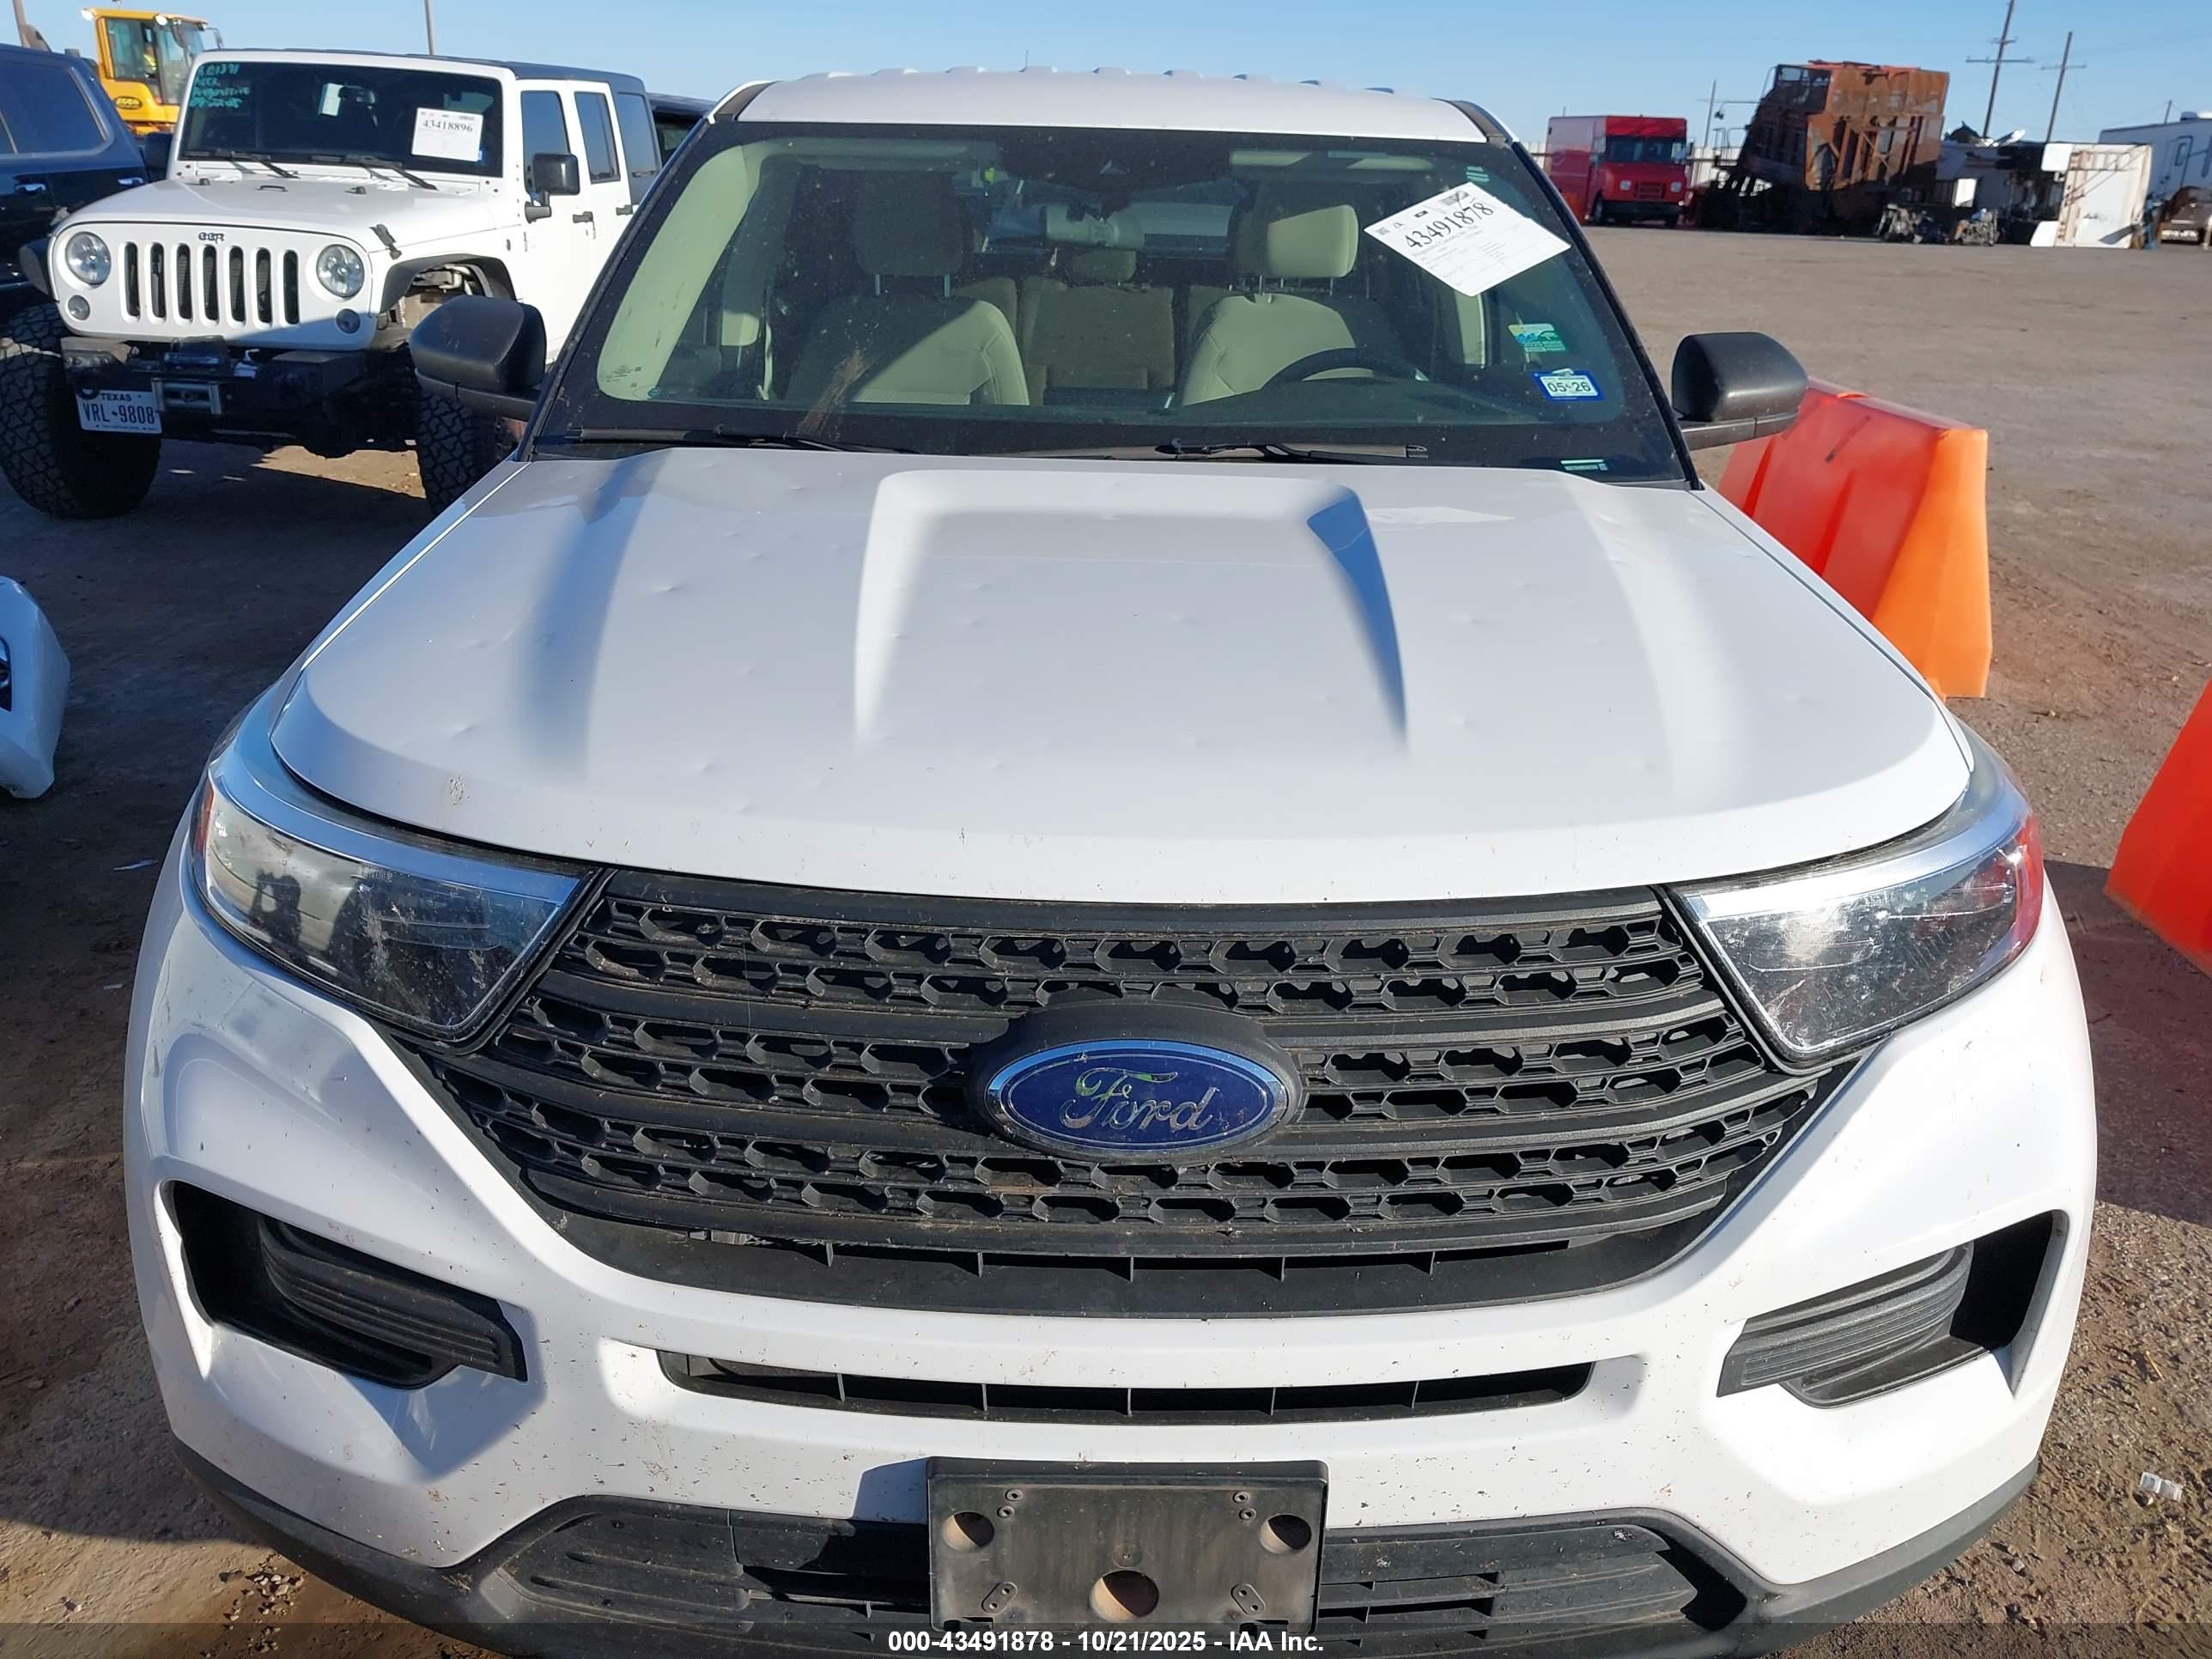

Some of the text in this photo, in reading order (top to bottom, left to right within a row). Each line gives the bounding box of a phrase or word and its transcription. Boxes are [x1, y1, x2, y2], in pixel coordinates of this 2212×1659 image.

[422, 119, 473, 132] 43418896
[1405, 202, 1495, 248] 43491878
[100, 393, 132, 402] TEXAS
[1059, 1066, 1220, 1130] Ford
